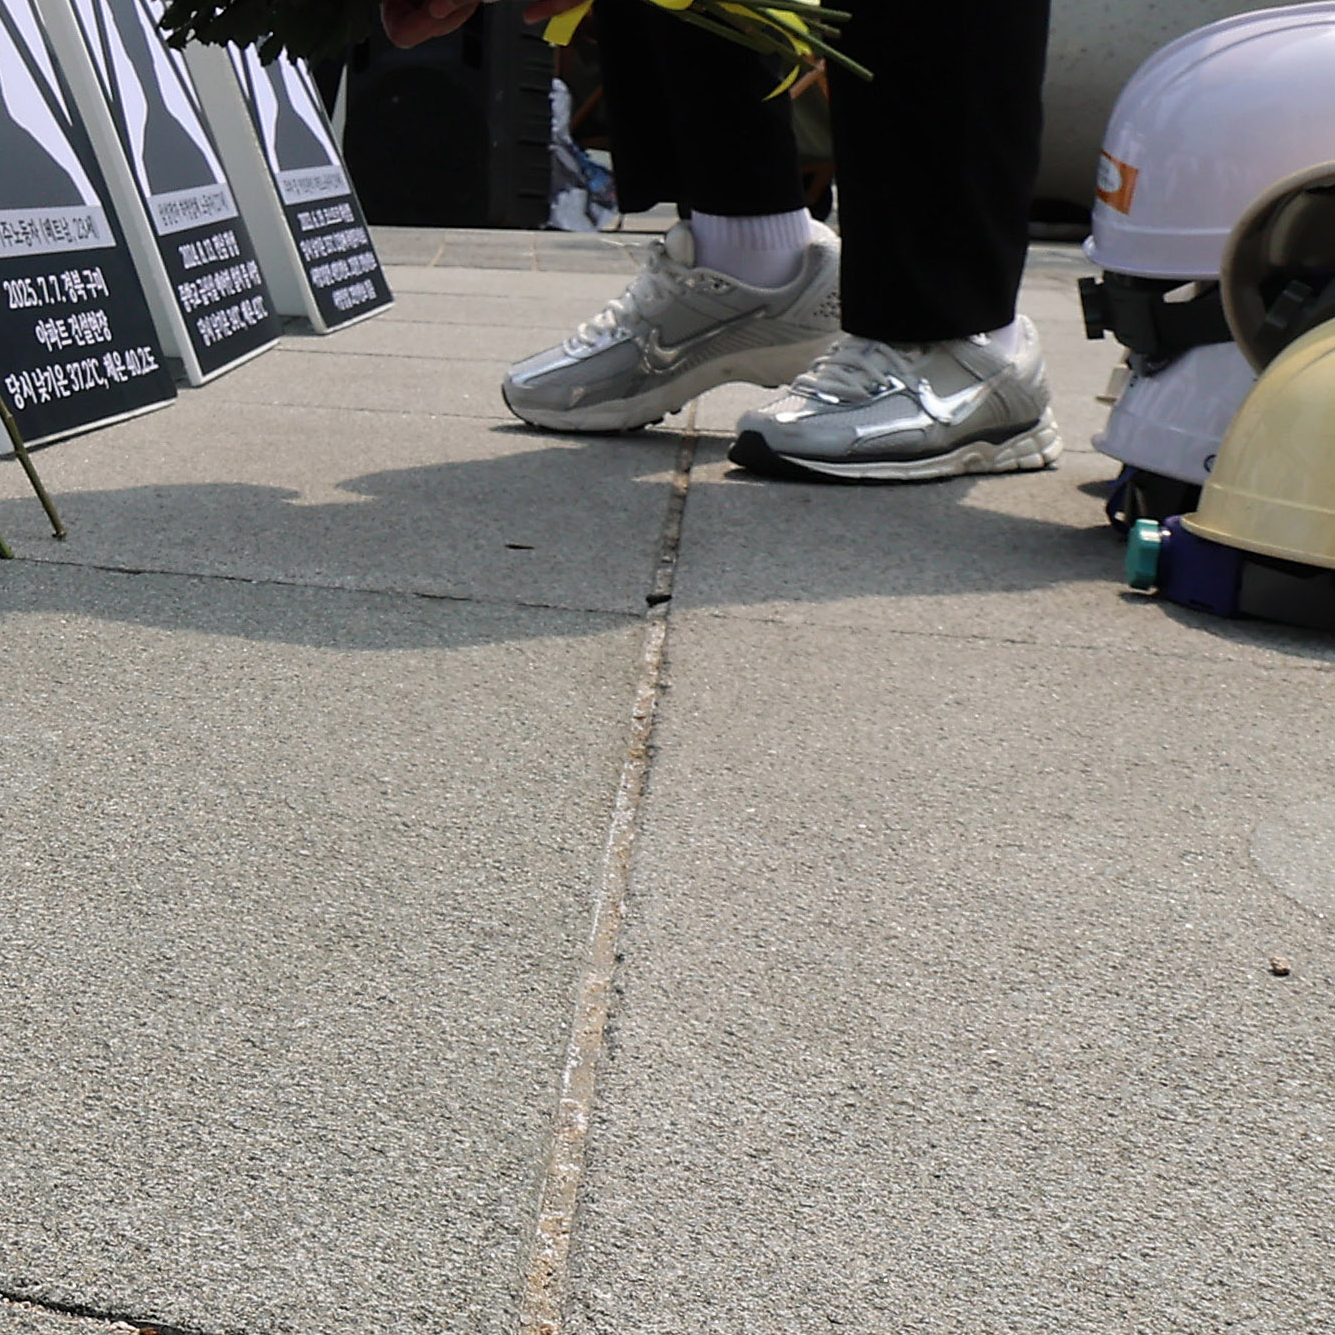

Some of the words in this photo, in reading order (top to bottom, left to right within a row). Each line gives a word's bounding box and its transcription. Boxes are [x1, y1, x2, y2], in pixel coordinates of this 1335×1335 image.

[3, 278, 43, 309] 2025.
[37, 276, 55, 305] 7.
[49, 274, 67, 302] 7.
[61, 269, 88, 303] 경북
[83, 266, 109, 298] 구미
[35, 317, 72, 352] 아파트
[68, 309, 112, 346] 건설현장
[4, 370, 38, 409] 당시
[31, 364, 71, 403] 낮기온
